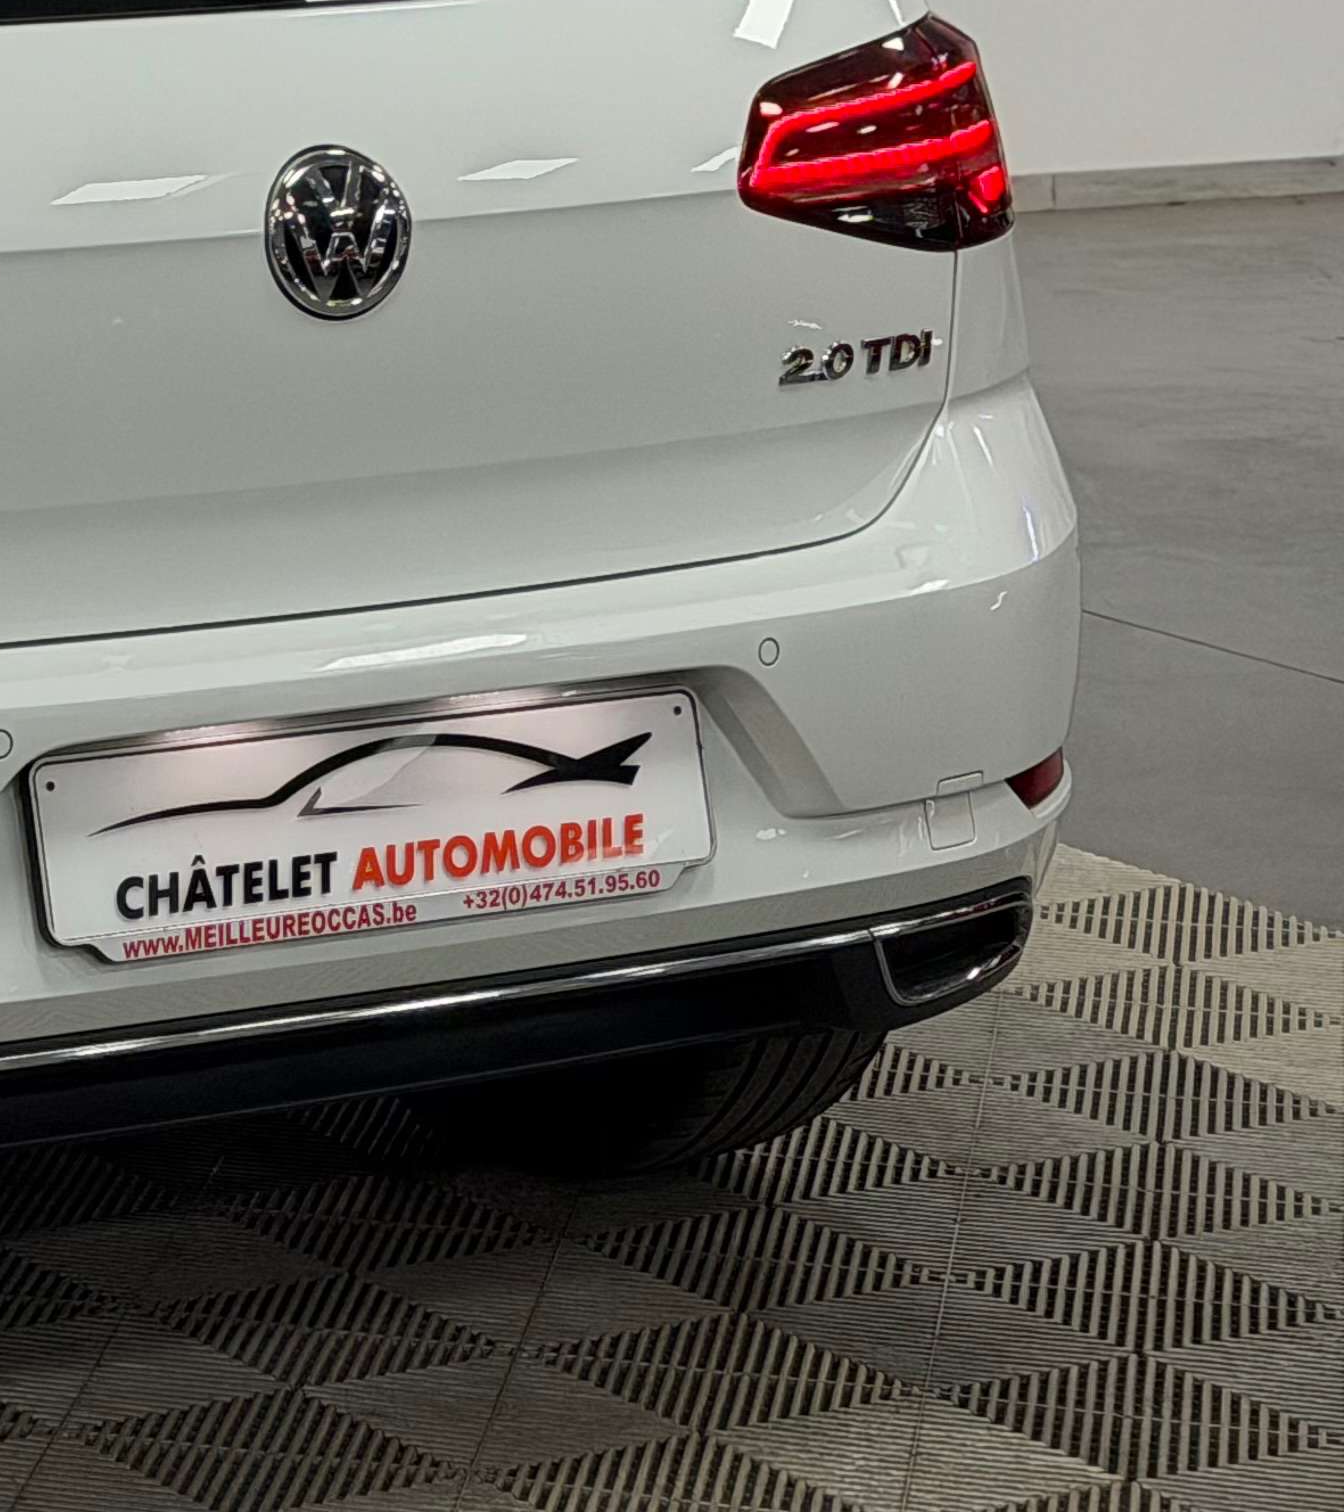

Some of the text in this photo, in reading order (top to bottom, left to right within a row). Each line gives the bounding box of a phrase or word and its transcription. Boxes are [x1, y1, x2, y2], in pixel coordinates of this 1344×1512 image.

[861, 329, 933, 374] TDI
[116, 814, 644, 921] CHÂTELET AUTOMOBILE
[463, 869, 661, 911] +32(0)474.51.95.60
